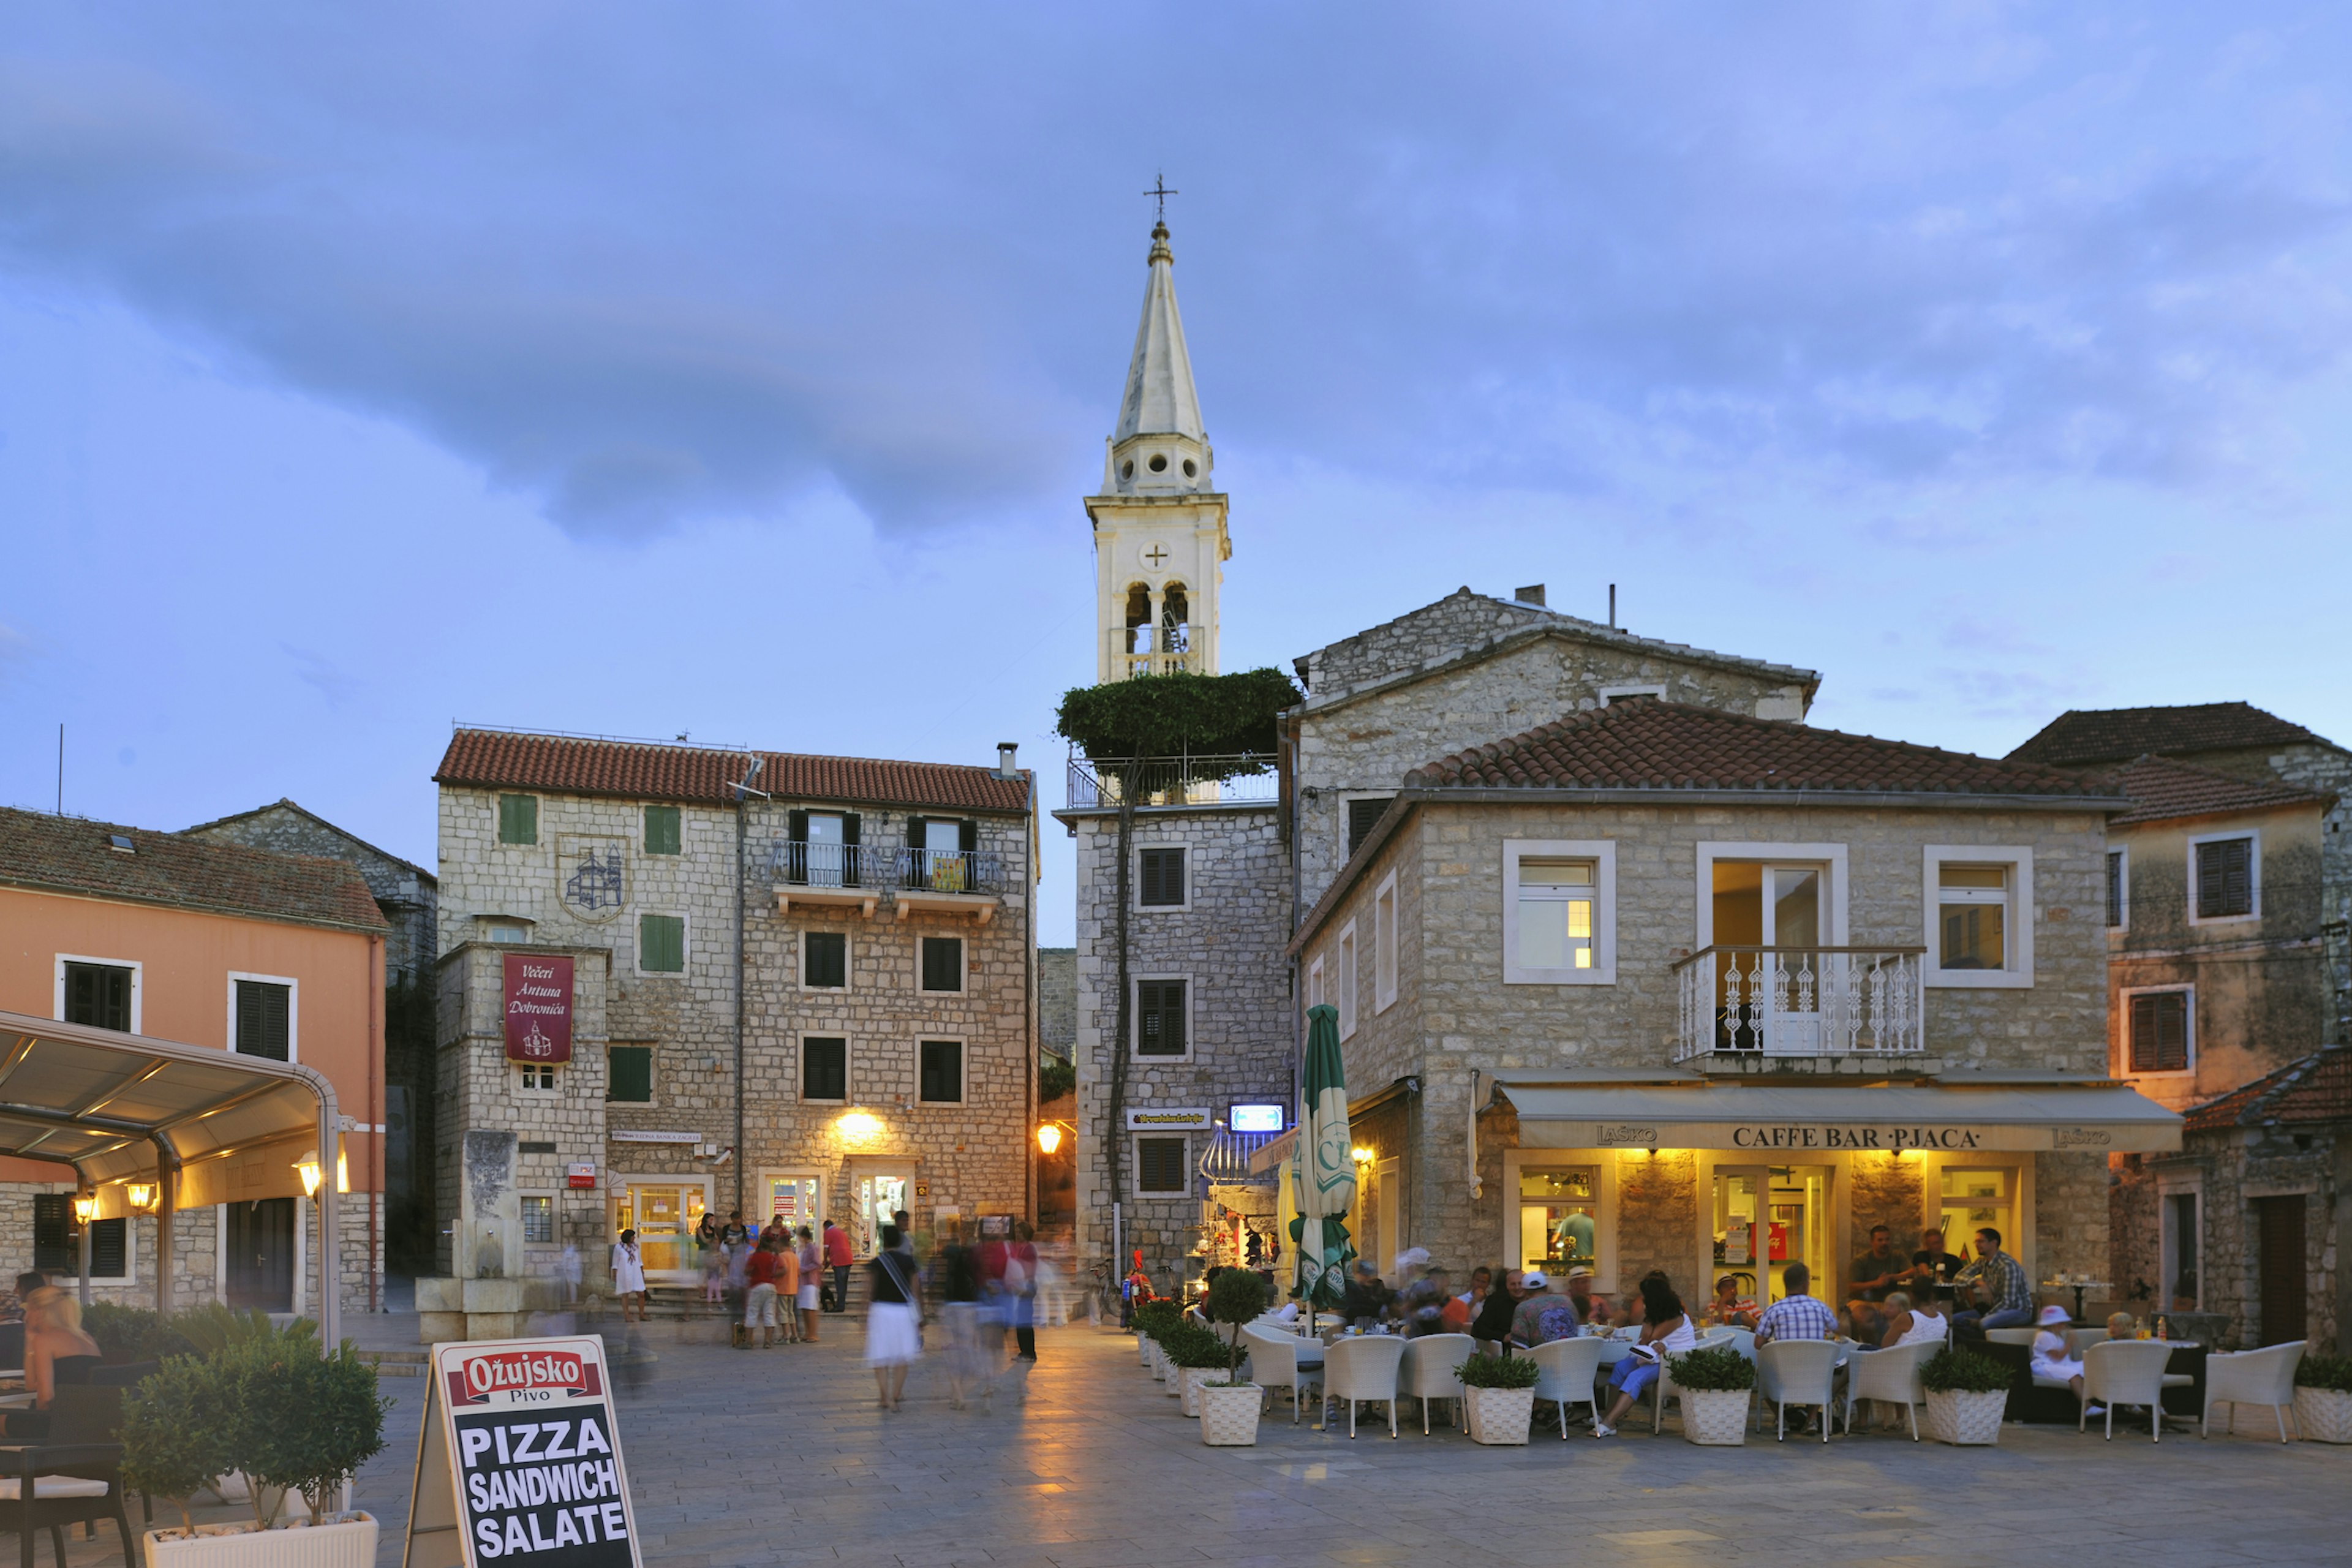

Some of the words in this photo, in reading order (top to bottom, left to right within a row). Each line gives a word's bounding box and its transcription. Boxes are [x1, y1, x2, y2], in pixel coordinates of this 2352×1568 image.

[522, 965, 554, 979] Večeri
[516, 982, 562, 998] Antuna
[509, 1000, 565, 1016] Dobronića
[1596, 1125, 1657, 1145] LAŠKO
[1733, 1127, 1818, 1147] CAFFE
[1826, 1128, 1879, 1148] BAR
[468, 1353, 579, 1392] Ožujsko
[510, 1389, 551, 1403] Pivo
[460, 1417, 611, 1468] PIZZA
[469, 1458, 620, 1513] SANDWICH
[476, 1501, 628, 1558] SALATE
